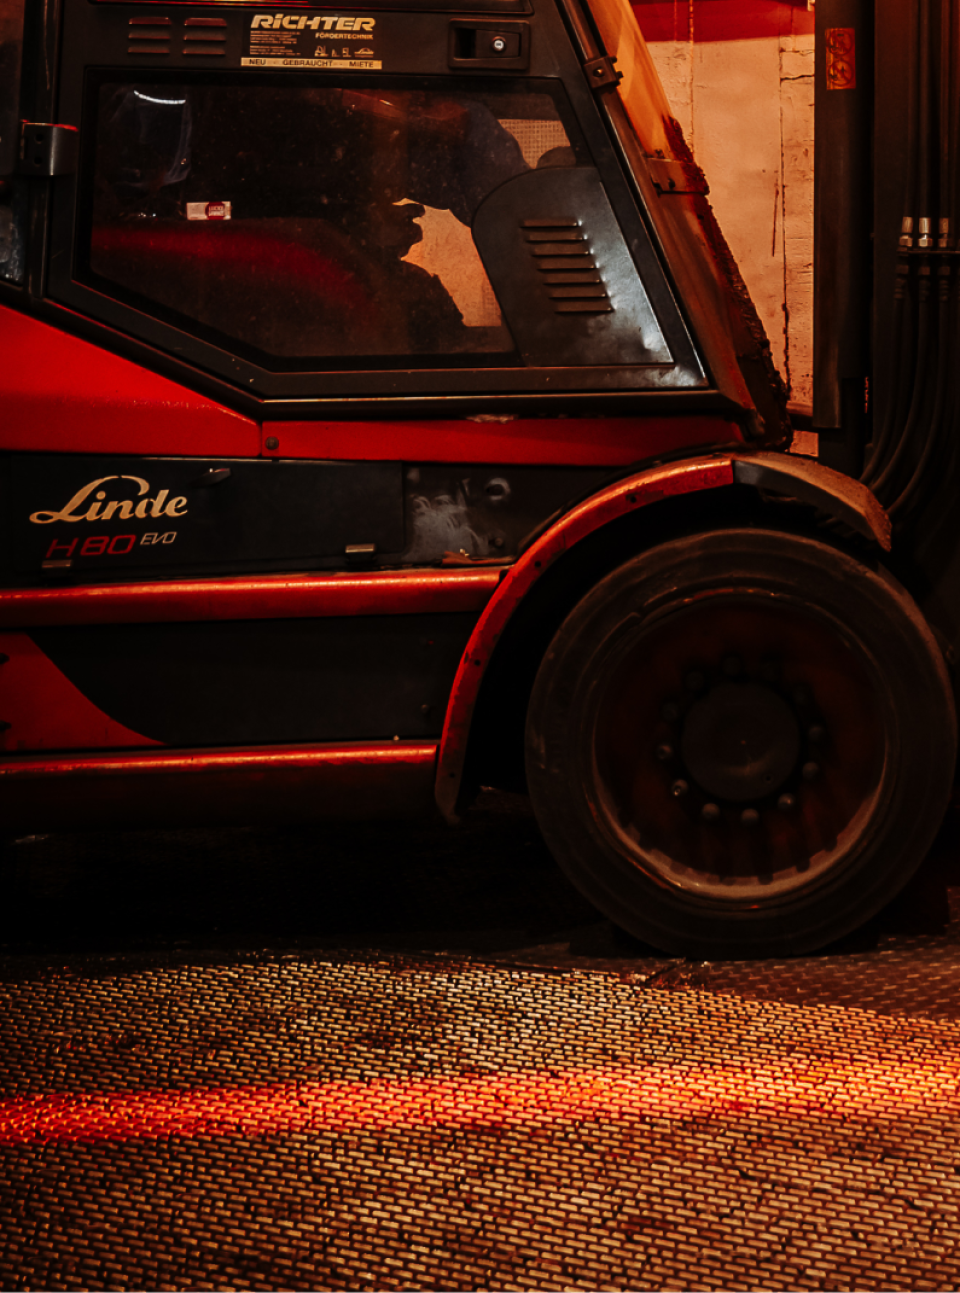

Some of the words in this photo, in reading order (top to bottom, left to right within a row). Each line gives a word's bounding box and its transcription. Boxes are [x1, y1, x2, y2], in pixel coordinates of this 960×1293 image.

[315, 31, 374, 40] FÖRDERTECHNIK
[282, 59, 333, 67] GEBRAUCHT
[349, 60, 374, 68] MIETE
[29, 474, 188, 524] Linde
[140, 531, 178, 546] EVO
